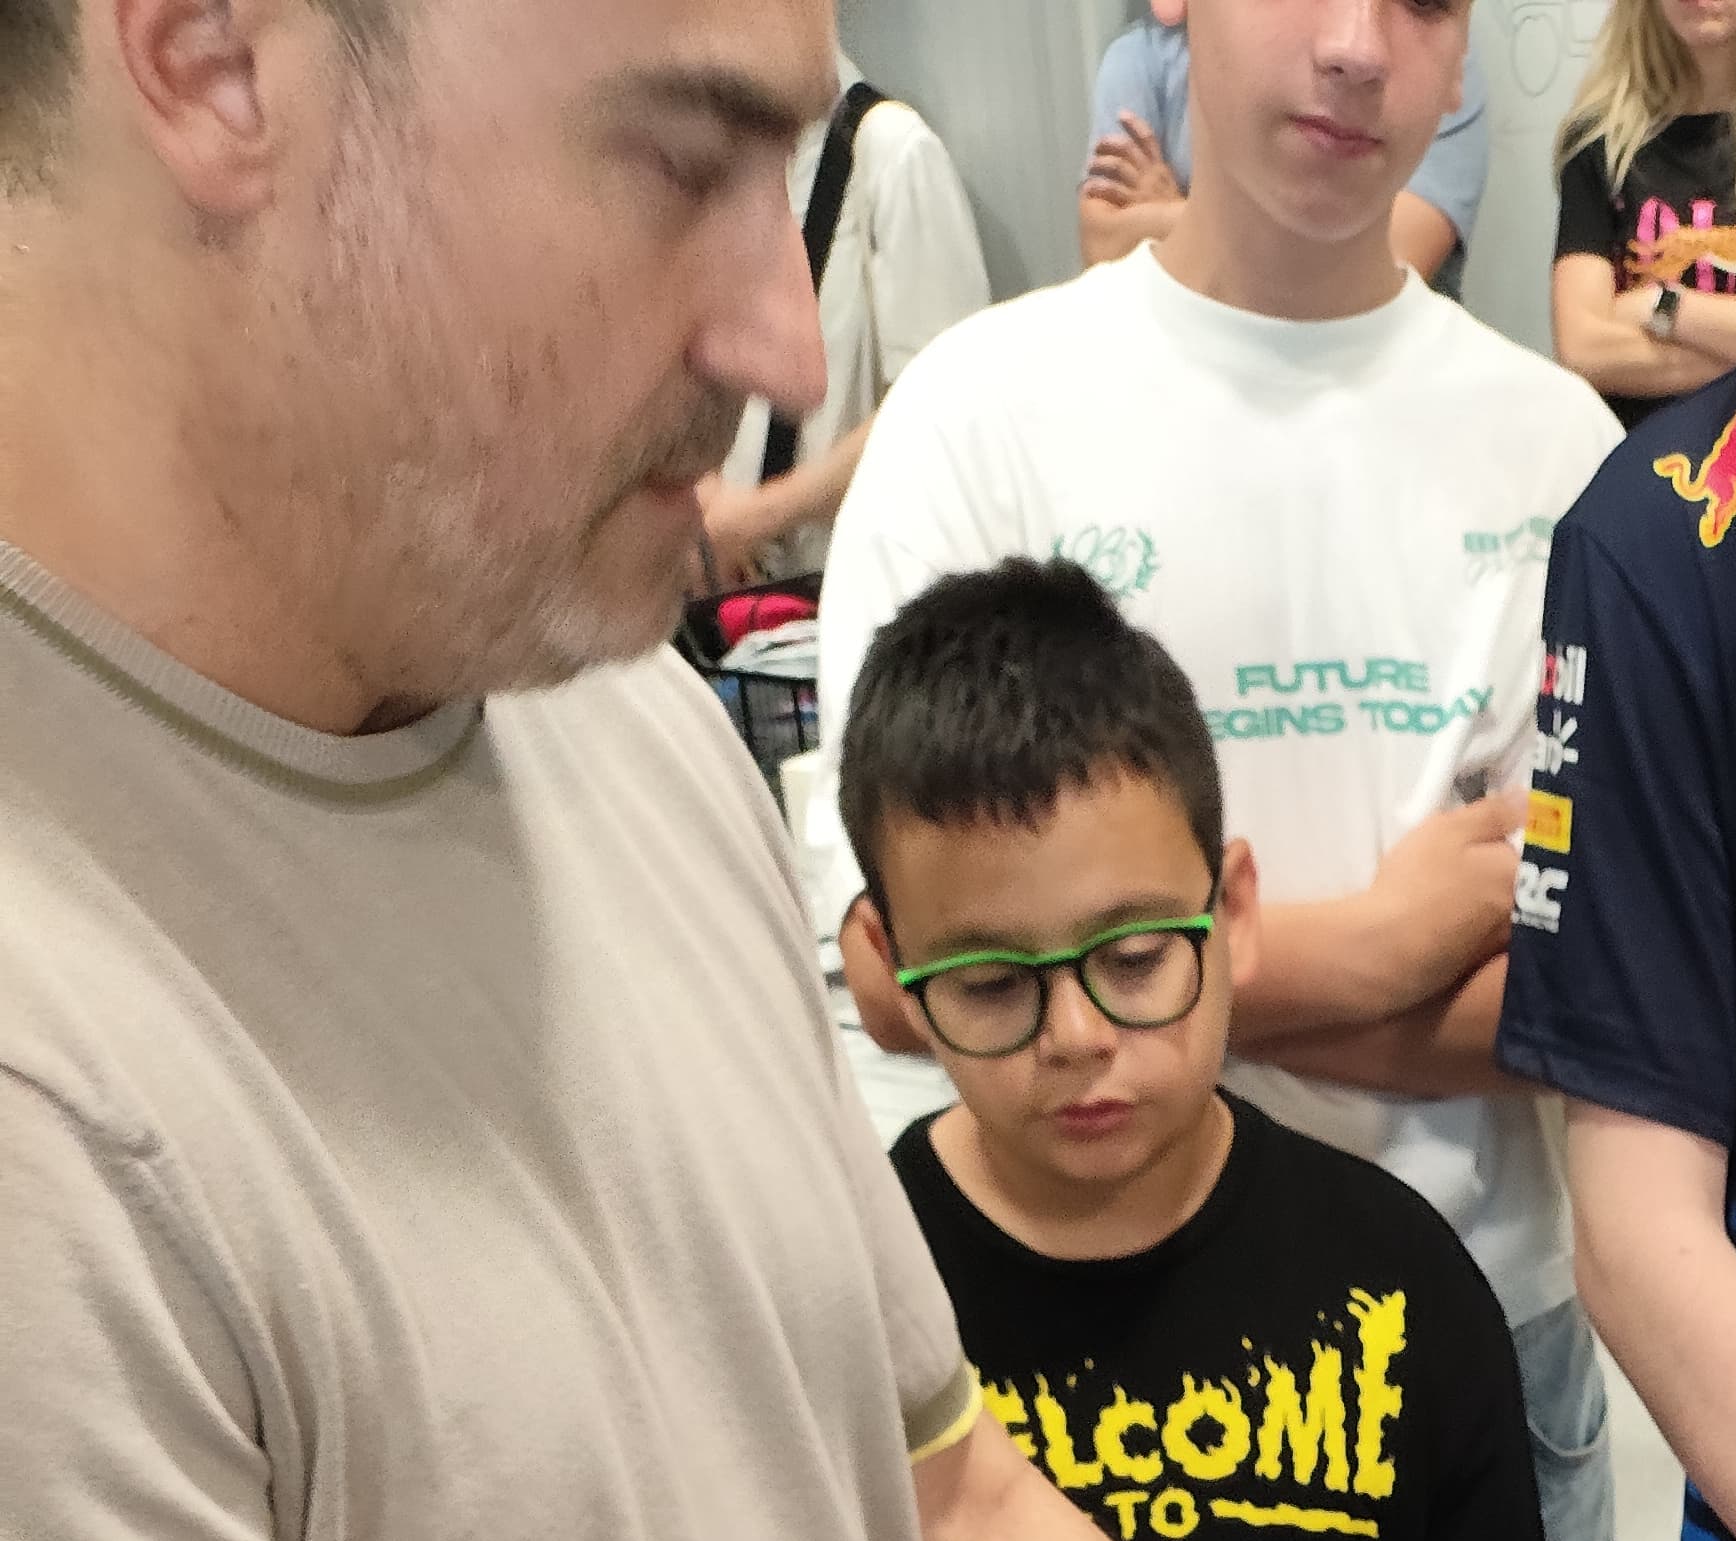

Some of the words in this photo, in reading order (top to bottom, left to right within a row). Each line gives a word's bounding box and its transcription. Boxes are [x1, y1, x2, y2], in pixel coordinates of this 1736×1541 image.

[1236, 658, 1431, 696] FUTURE
[1204, 702, 1345, 740] EGINS
[1358, 686, 1494, 735] TODAY
[982, 1287, 1406, 1500] ELCOME
[1104, 1488, 1201, 1541] TO
